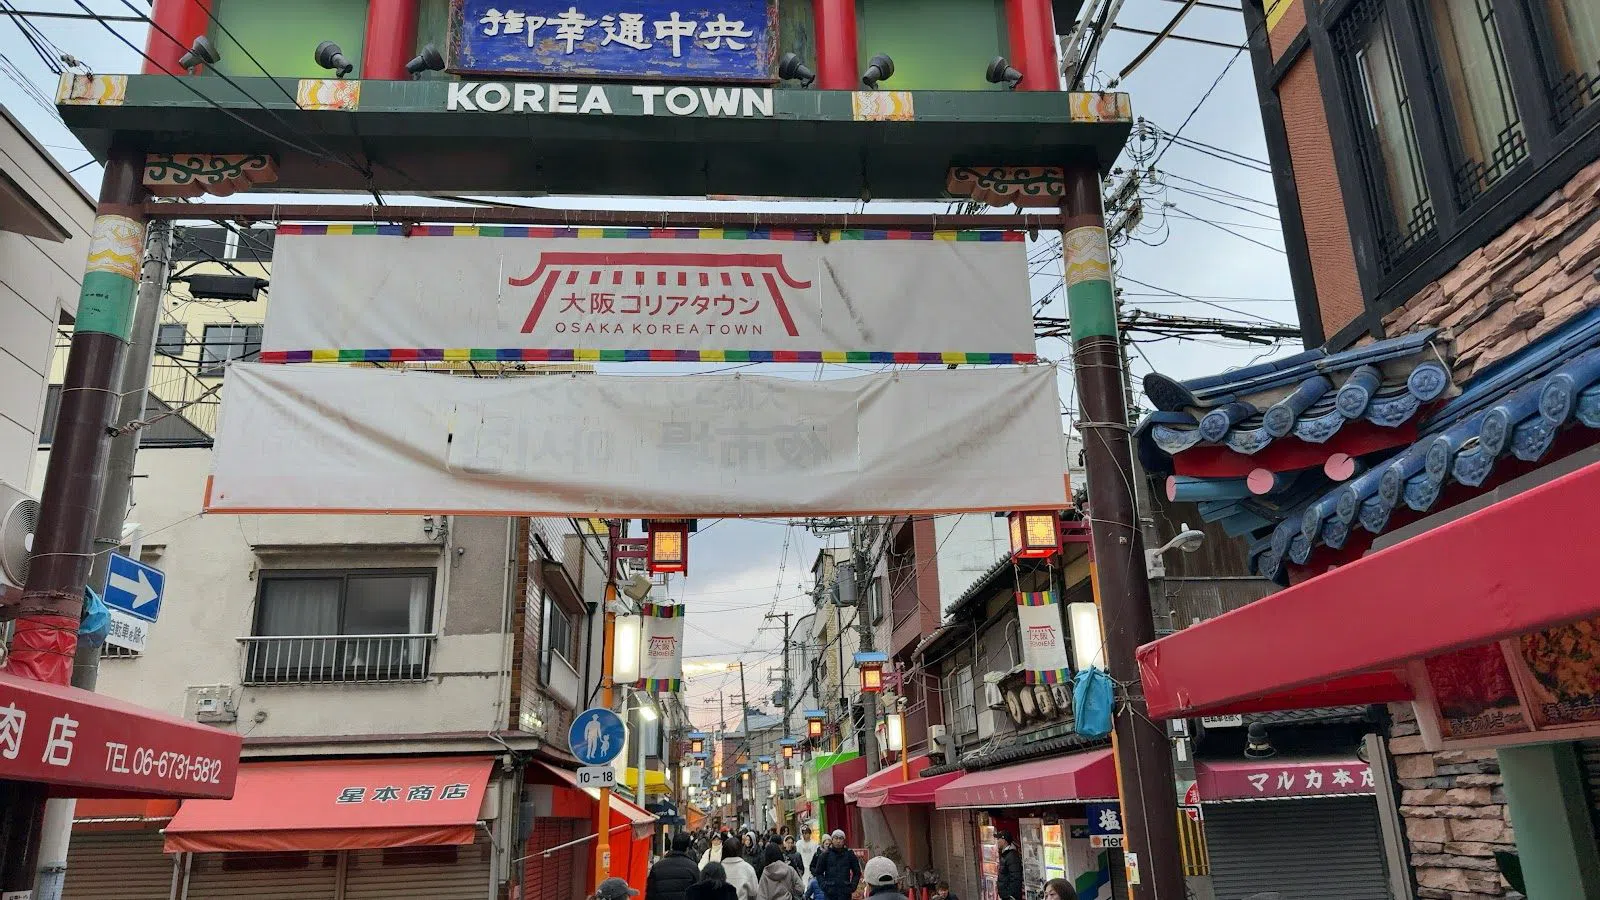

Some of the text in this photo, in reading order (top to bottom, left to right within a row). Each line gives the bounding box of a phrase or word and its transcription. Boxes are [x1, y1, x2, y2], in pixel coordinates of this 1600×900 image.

[480, 7, 753, 58] 御幸通中央
[446, 82, 774, 117] KOREA TOWN
[559, 292, 760, 316] 大阪コリアタウン
[555, 322, 763, 335] OSAKA KOREA TOWN
[105, 741, 222, 784] TEL 06-6731-5812
[336, 784, 470, 804] 星本商店
[1098, 808, 1122, 831] 塩
